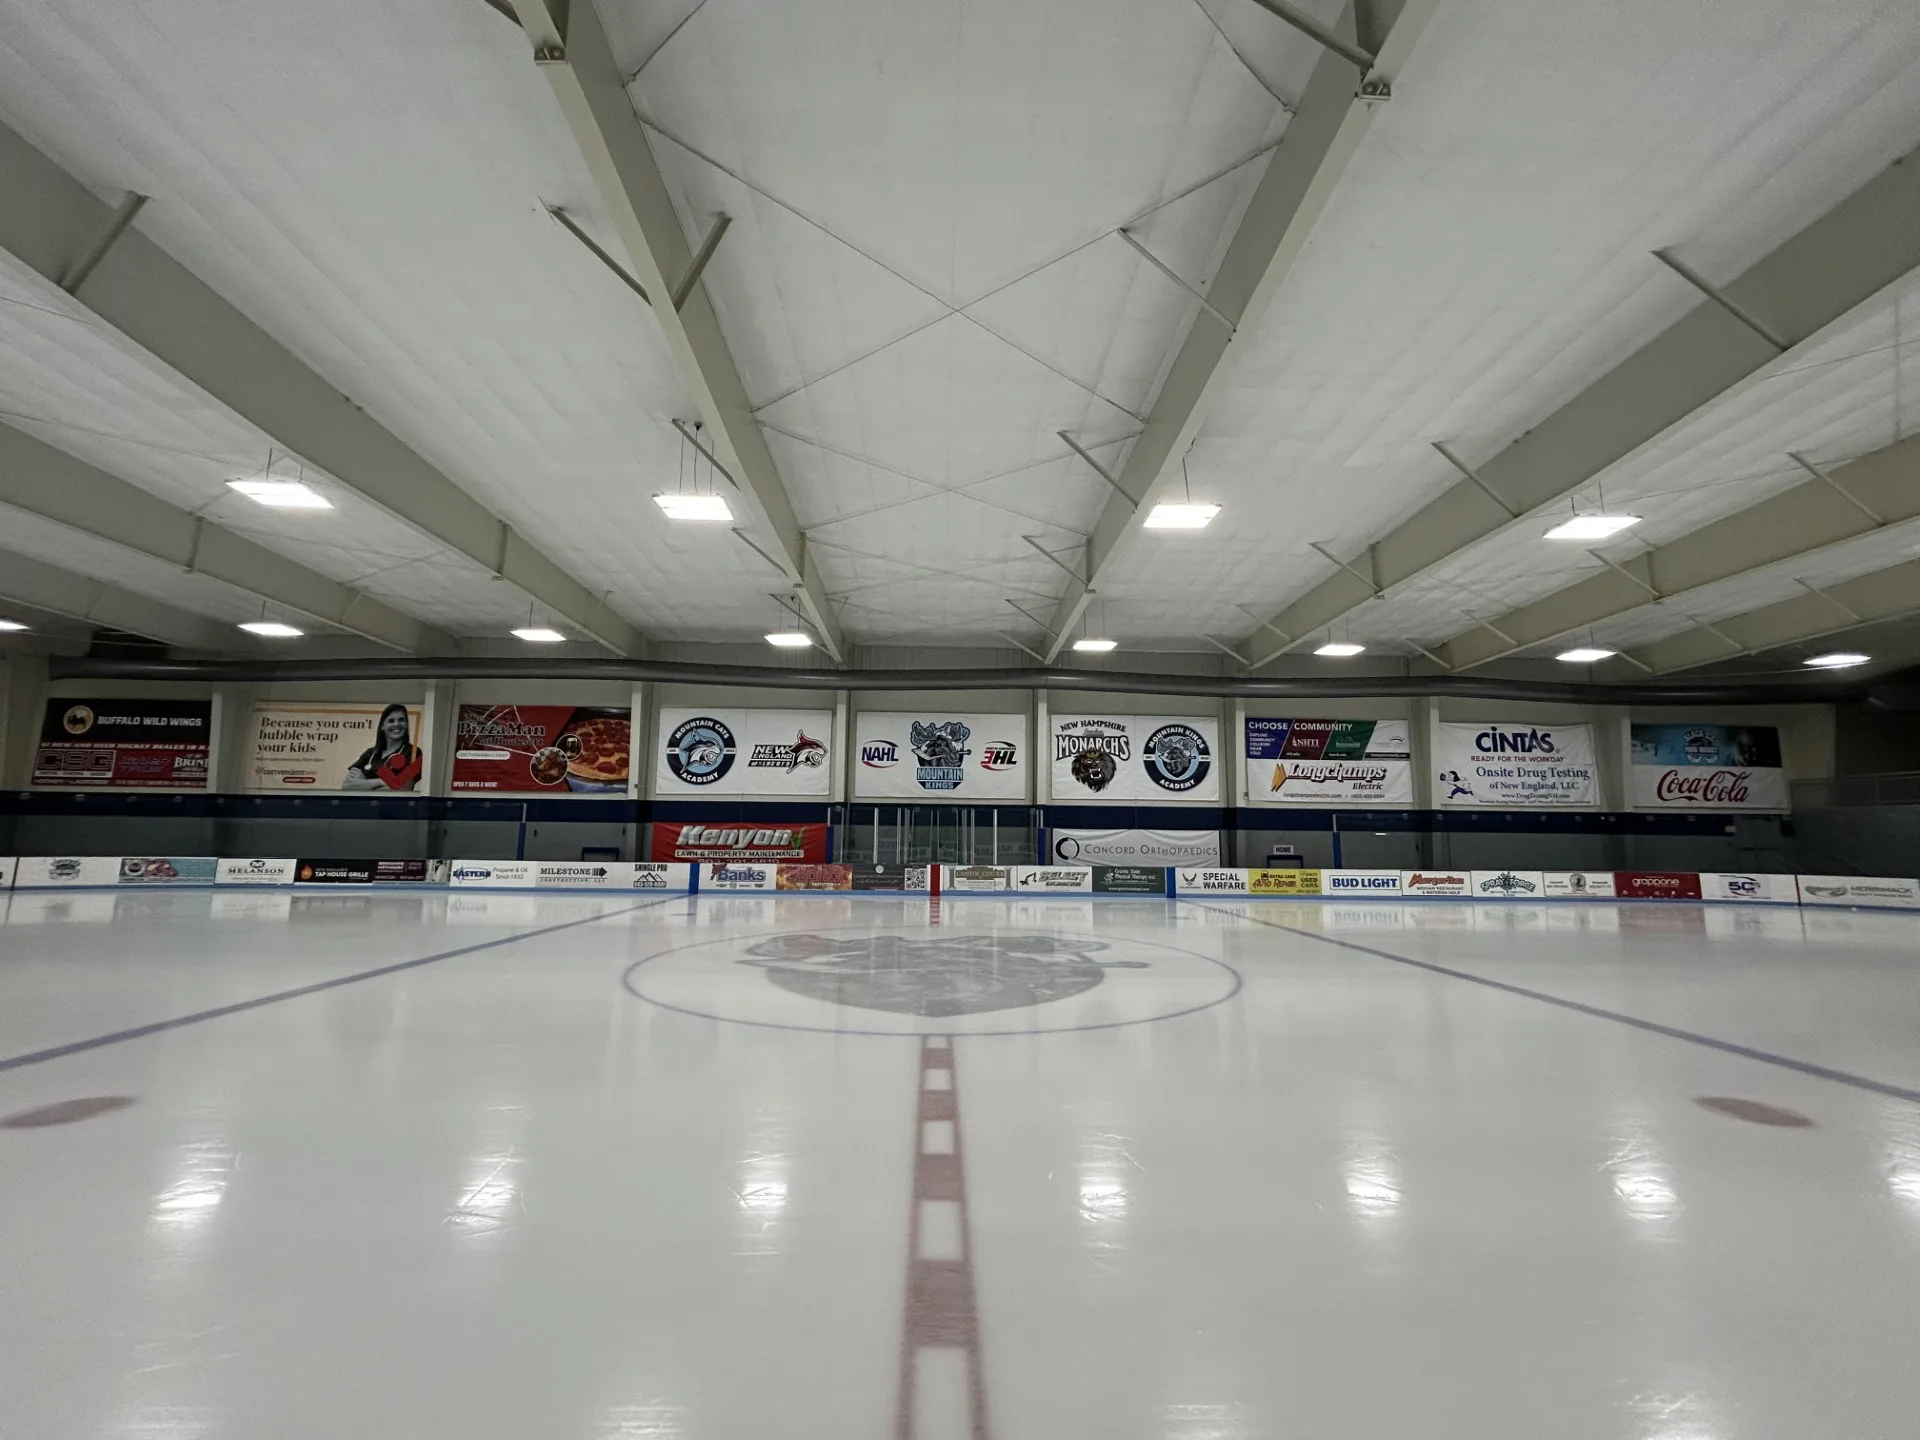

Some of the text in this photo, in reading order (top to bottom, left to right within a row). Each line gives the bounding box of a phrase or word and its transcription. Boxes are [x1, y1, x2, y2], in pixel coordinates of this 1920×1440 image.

[97, 716, 203, 727] BUFFALO WILD WINGS
[261, 717, 373, 731] Because you can't
[1060, 720, 1126, 733] NEW HAMPSHIRE
[1248, 721, 1353, 731] CHOOSE COMMUNITY
[458, 721, 545, 736] PizzaMan
[675, 720, 730, 739] MOUNTAIN CATS
[259, 730, 339, 743] bubble wrap
[1148, 727, 1205, 749] MOUNTAIN KINGS
[1475, 726, 1555, 753] CINTAS
[256, 742, 317, 754] your kids
[755, 746, 789, 754] NEW
[1056, 734, 1131, 761] MONARCHS
[861, 747, 899, 761] NAHL
[681, 772, 718, 782] ACADEMY
[917, 768, 963, 780] MOUNTAIN
[1288, 762, 1387, 782] Longchamps
[1476, 766, 1590, 780] Onsite Drug Testing
[1159, 779, 1195, 789] ACADEMY
[1352, 782, 1384, 790] Electric
[1521, 782, 1559, 791] England,
[1657, 769, 1752, 802] Coca-Cola
[676, 825, 792, 849] Kenyon
[1085, 844, 1218, 855] CONCORD ORTHOPAEDICS
[656, 864, 668, 872] PRO
[717, 867, 766, 881] Banks
[1202, 872, 1241, 880] SPECIAL
[1203, 882, 1246, 890] WARFARE
[1332, 878, 1398, 888] BUD LIGHT
[1481, 879, 1505, 892] SPRAY
[1509, 878, 1536, 892] FORGE
[1631, 878, 1680, 887] grappone
